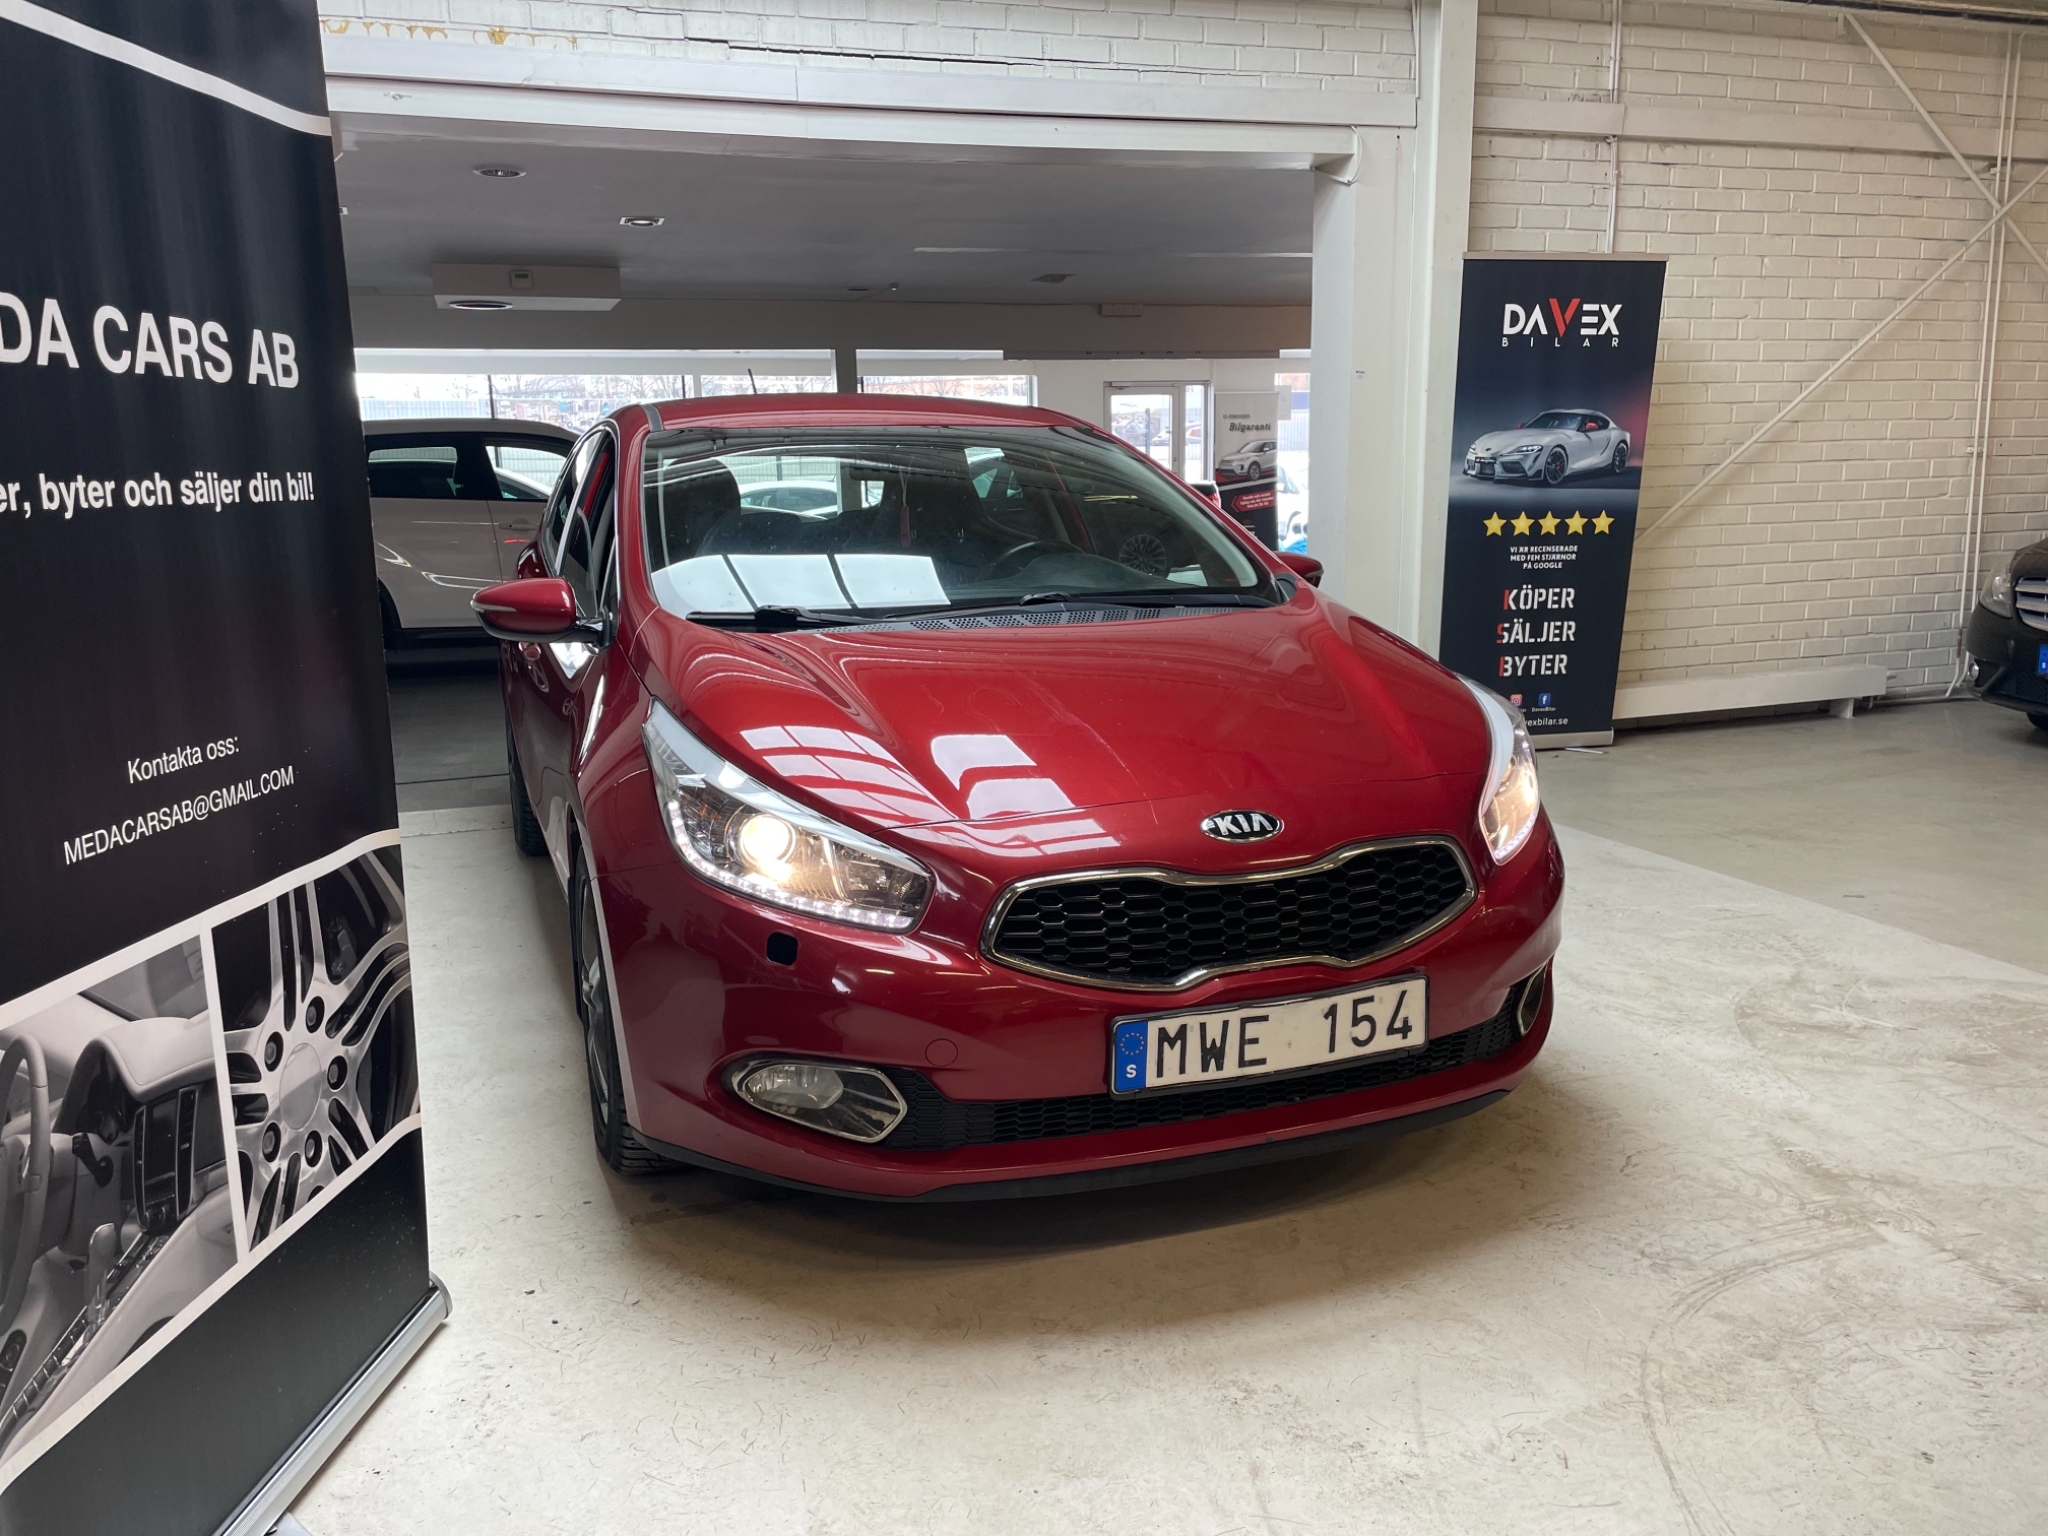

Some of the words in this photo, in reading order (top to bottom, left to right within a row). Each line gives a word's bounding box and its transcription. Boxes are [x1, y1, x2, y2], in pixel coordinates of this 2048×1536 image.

[1503, 298, 1622, 337] DAVEX
[93, 305, 233, 384] CARS
[248, 328, 299, 389] AB
[1502, 337, 1618, 347] BILAR
[1229, 422, 1271, 433] Bilgaranti
[38, 472, 116, 520] byter
[124, 471, 173, 508] och
[180, 470, 242, 513] säljer
[249, 471, 283, 503] din
[286, 471, 315, 502] bil!
[1530, 545, 1578, 553] RECENSERADE
[1541, 553, 1577, 561] STJÄRNOR
[1523, 561, 1532, 569] PÅ
[1533, 561, 1563, 569] GOOGLE
[1503, 584, 1575, 611] KÖPER
[1496, 618, 1576, 644] SÄLJER
[1499, 654, 1568, 677] BYTER
[127, 746, 203, 784] Kontakta
[206, 736, 239, 760] oss:
[63, 765, 295, 866] MEDACARSAB@GMAIL.COM
[1213, 813, 1274, 836] KIA
[1156, 1014, 1269, 1078] MWE
[1323, 990, 1413, 1053] 154
[1126, 1064, 1137, 1079] S
